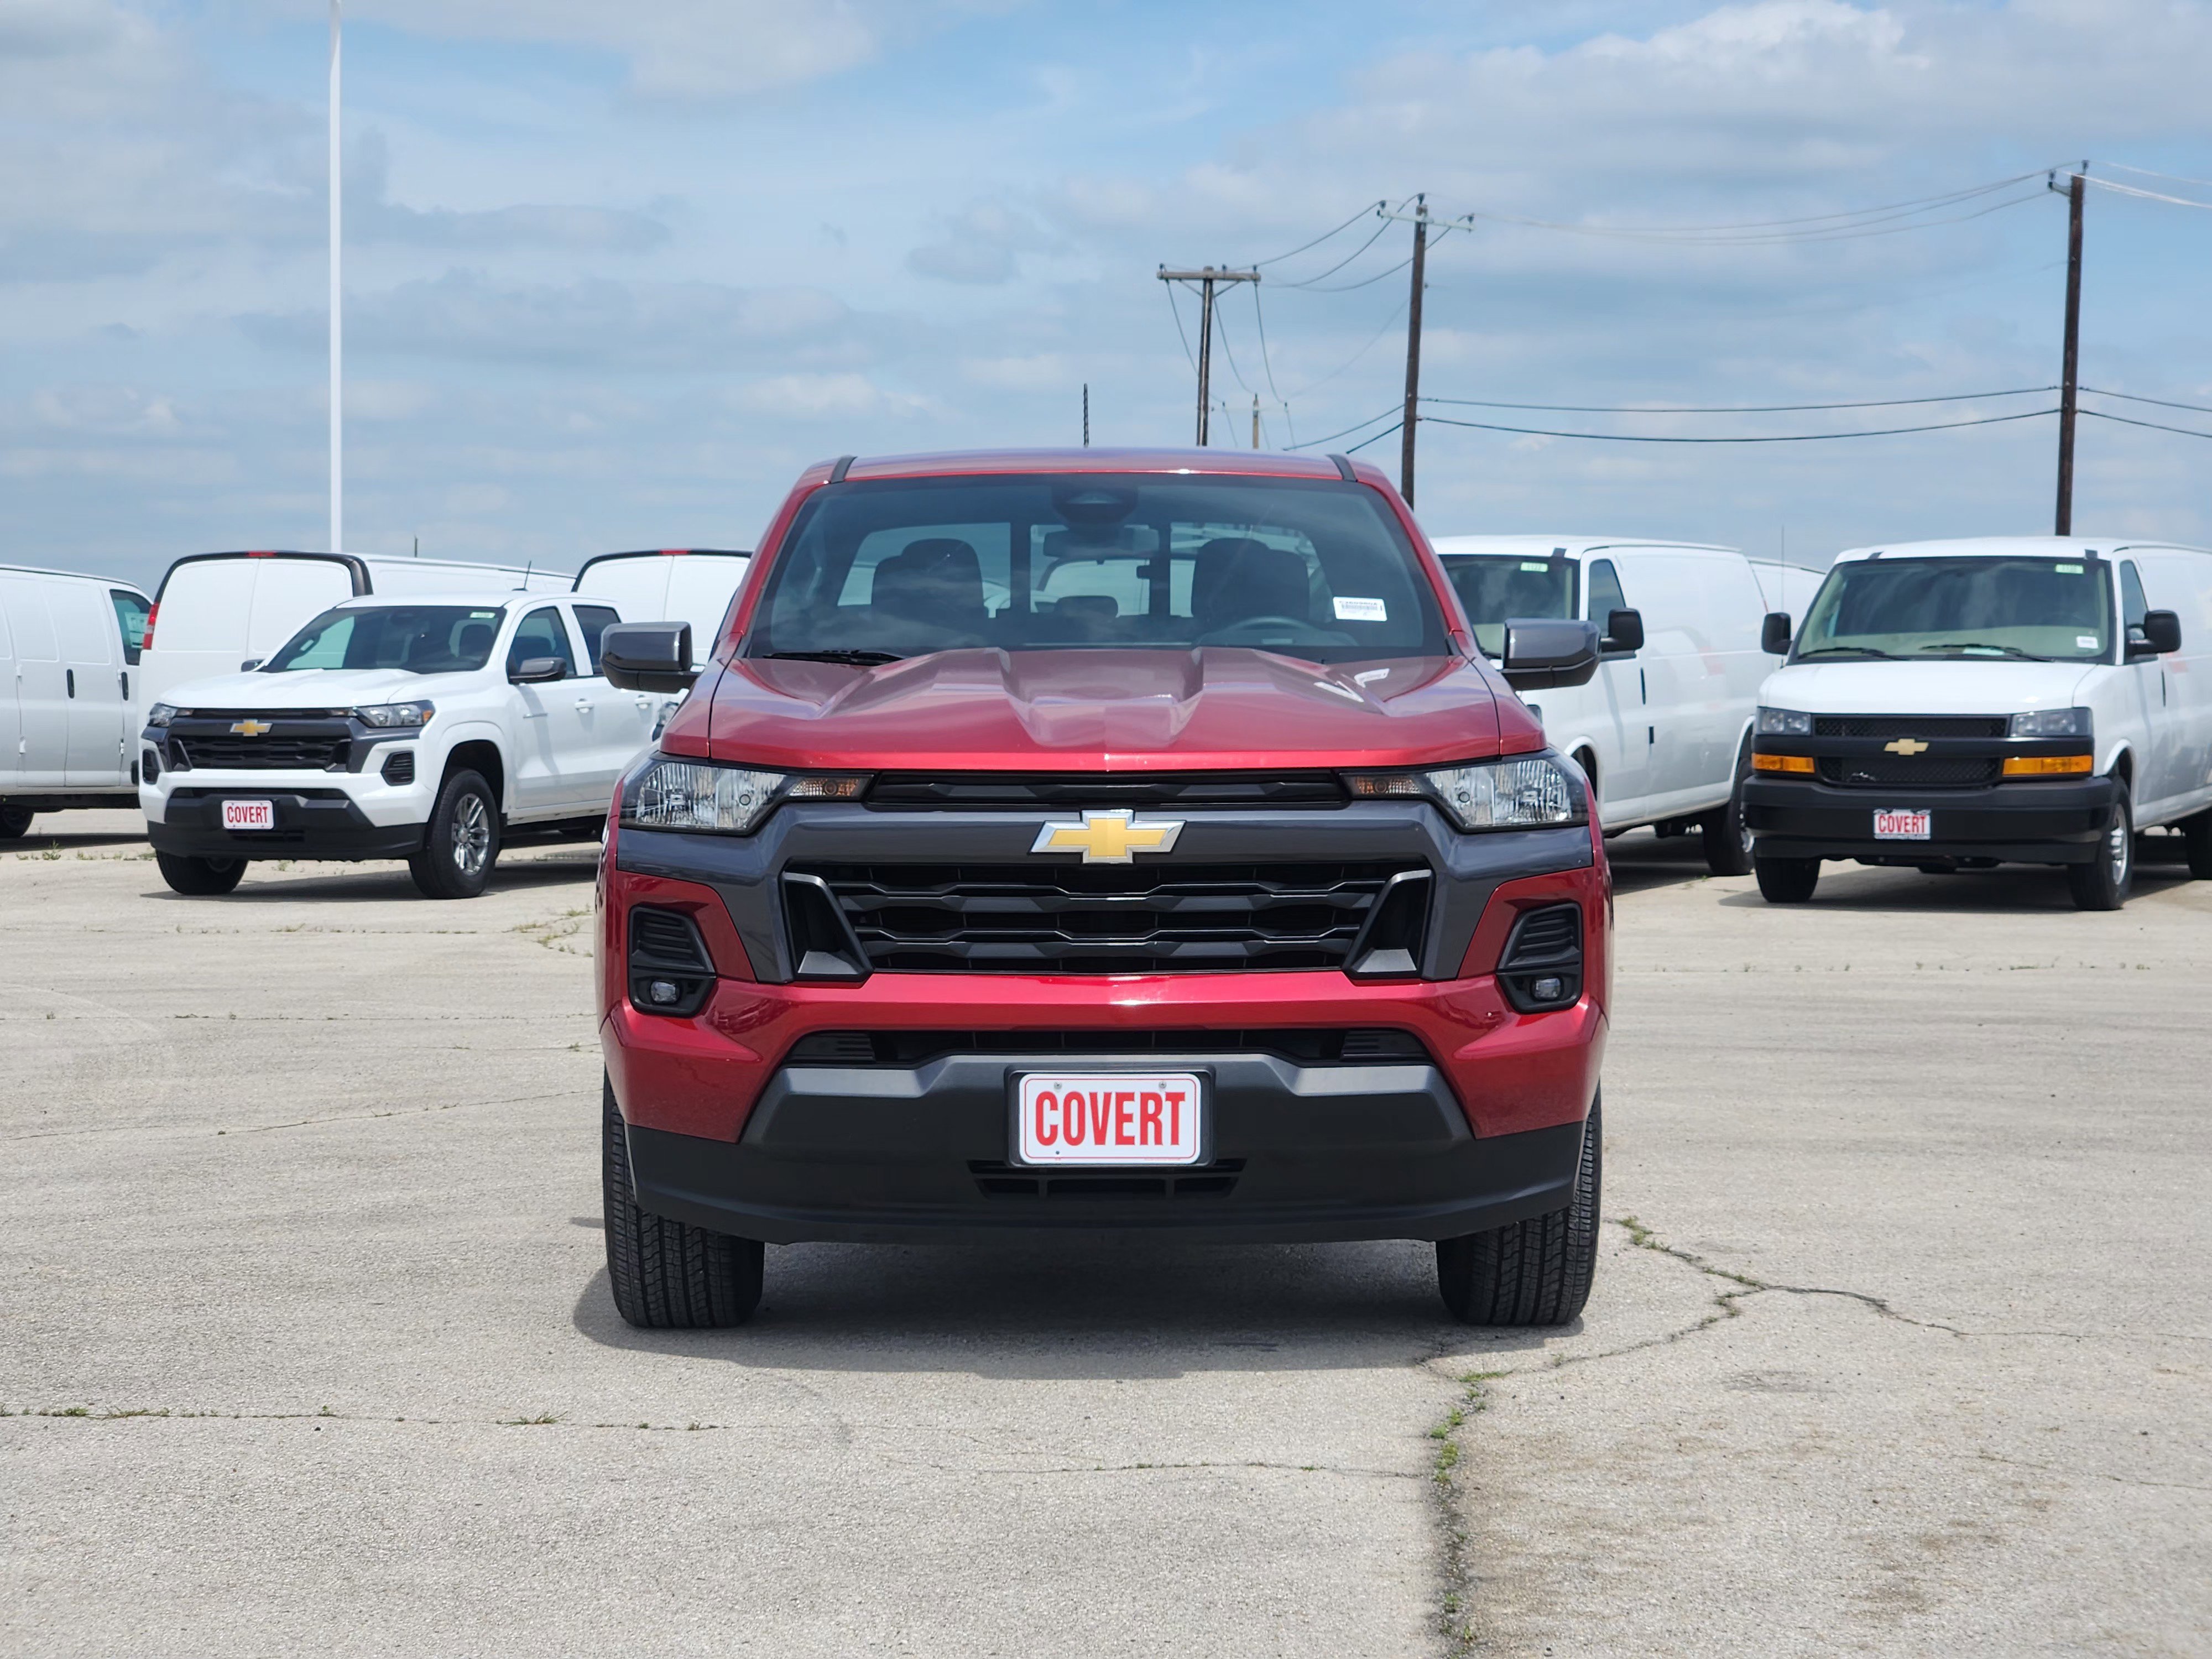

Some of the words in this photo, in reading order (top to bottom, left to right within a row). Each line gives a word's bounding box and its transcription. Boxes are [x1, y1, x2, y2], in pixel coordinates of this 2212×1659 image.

[227, 806, 268, 823] COVERT
[1879, 814, 1926, 833] COVERT
[1035, 1091, 1186, 1146] COVERT
